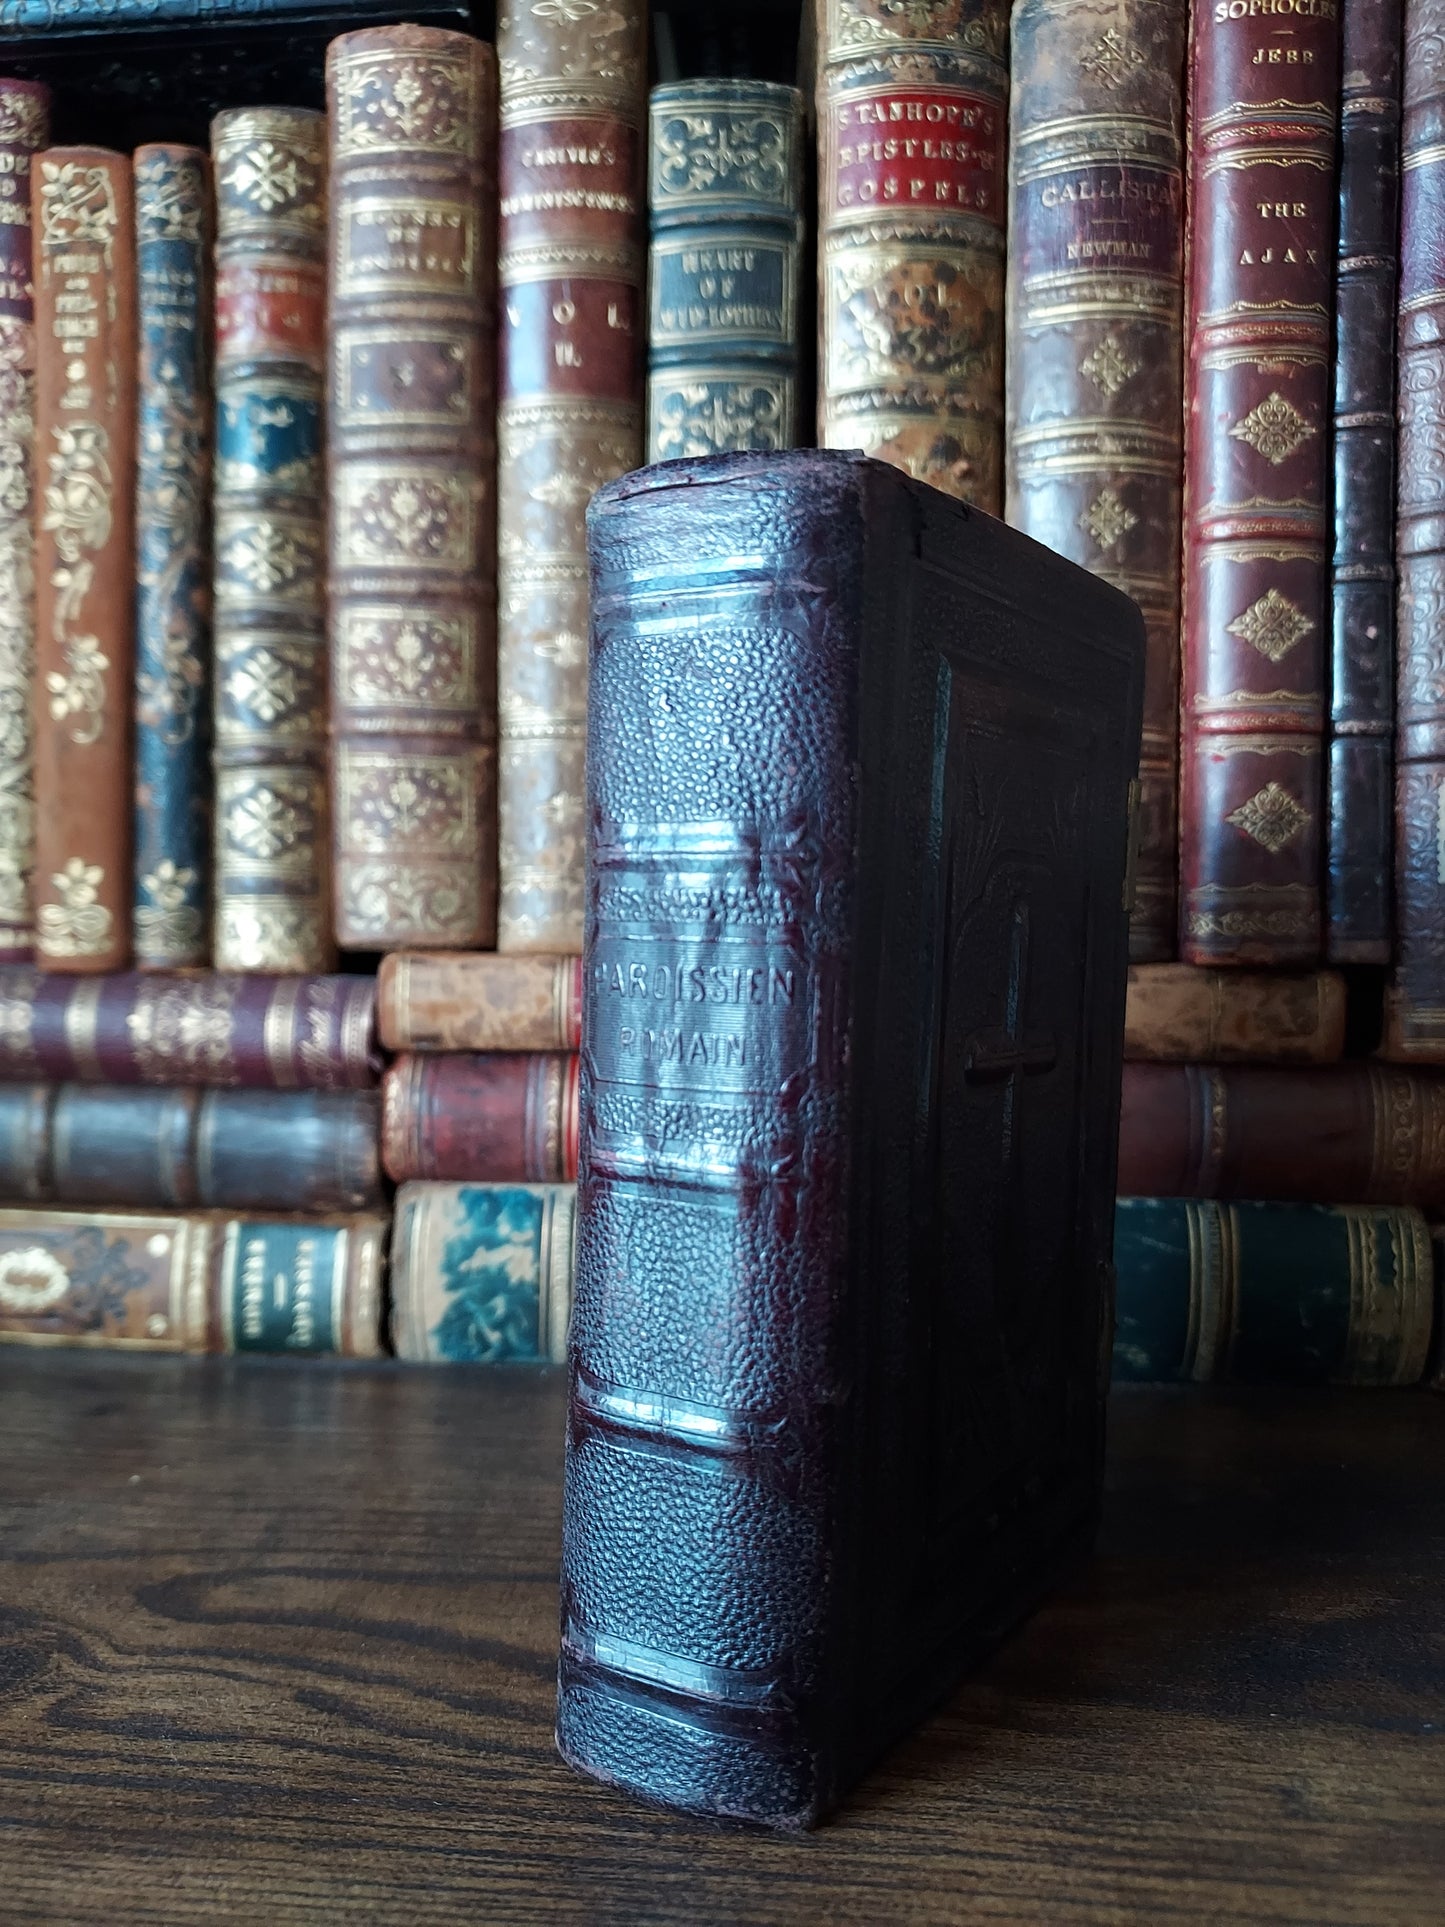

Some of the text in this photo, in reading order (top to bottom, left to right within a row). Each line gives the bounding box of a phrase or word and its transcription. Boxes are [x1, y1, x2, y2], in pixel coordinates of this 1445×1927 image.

[1252, 48, 1313, 64] JEBB
[838, 102, 994, 136] STANHOPE'S
[838, 178, 989, 208] GOSPELS
[1042, 179, 1171, 207] CALLISTA
[1256, 202, 1306, 218] THE
[1067, 241, 1151, 259] NEWMAN
[1240, 248, 1317, 265] AJAX
[700, 275, 735, 299] OF
[594, 962, 794, 1005] PAROISSIEN
[621, 1025, 745, 1066] ROMAIN
